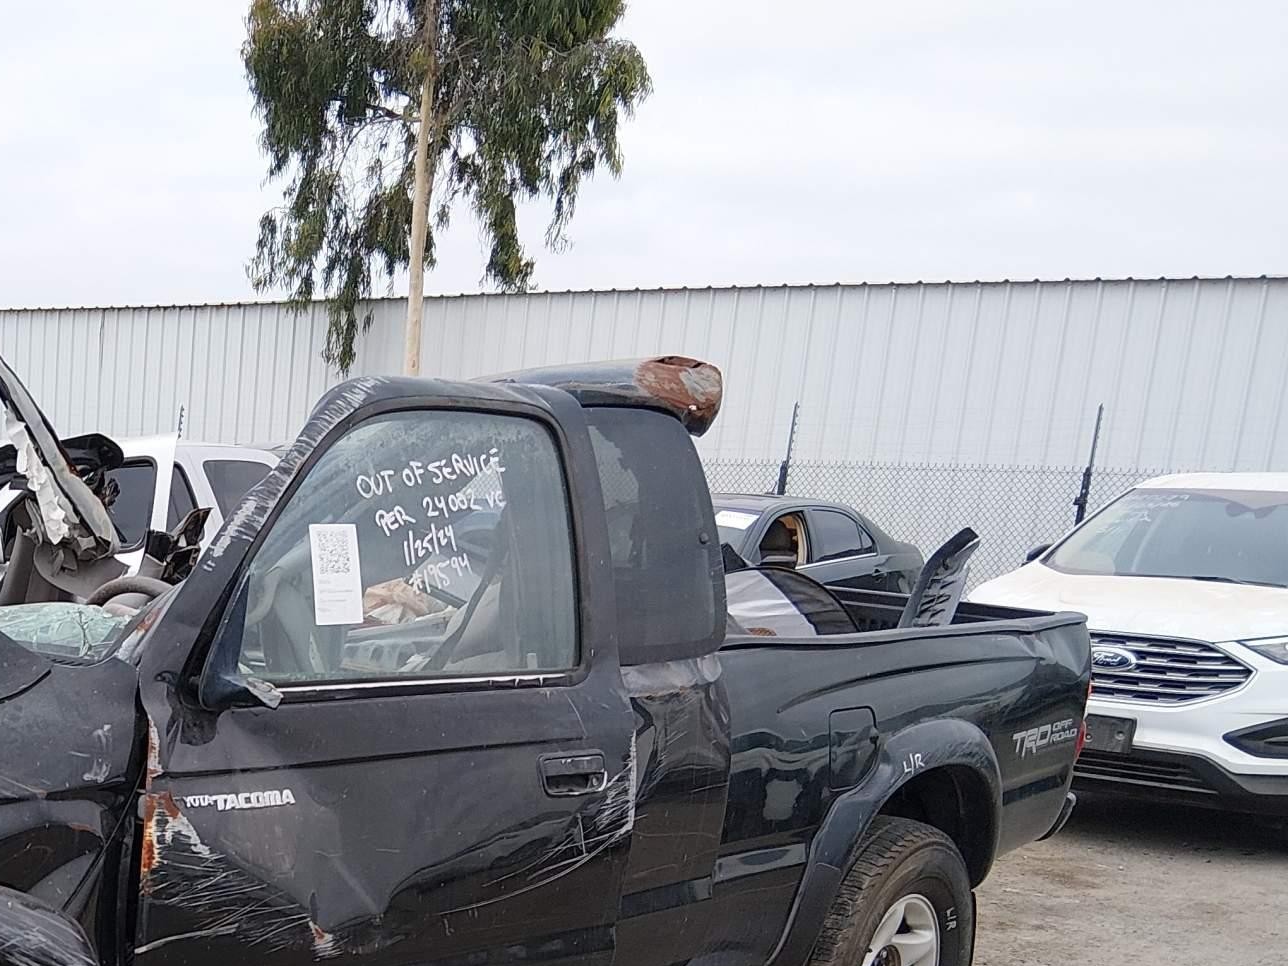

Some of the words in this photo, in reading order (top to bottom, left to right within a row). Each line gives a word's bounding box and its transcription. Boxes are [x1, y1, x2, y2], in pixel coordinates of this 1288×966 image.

[356, 470, 394, 499] OUT
[402, 461, 424, 487] OF
[427, 447, 506, 484] SERVICE
[375, 505, 416, 537] PER
[403, 522, 457, 567] 1/25/24
[1012, 723, 1052, 758] TRD
[1052, 718, 1073, 731] OFF
[1049, 727, 1078, 743] ROAD
[903, 753, 925, 775] L/R
[213, 789, 296, 811] TACOMA
